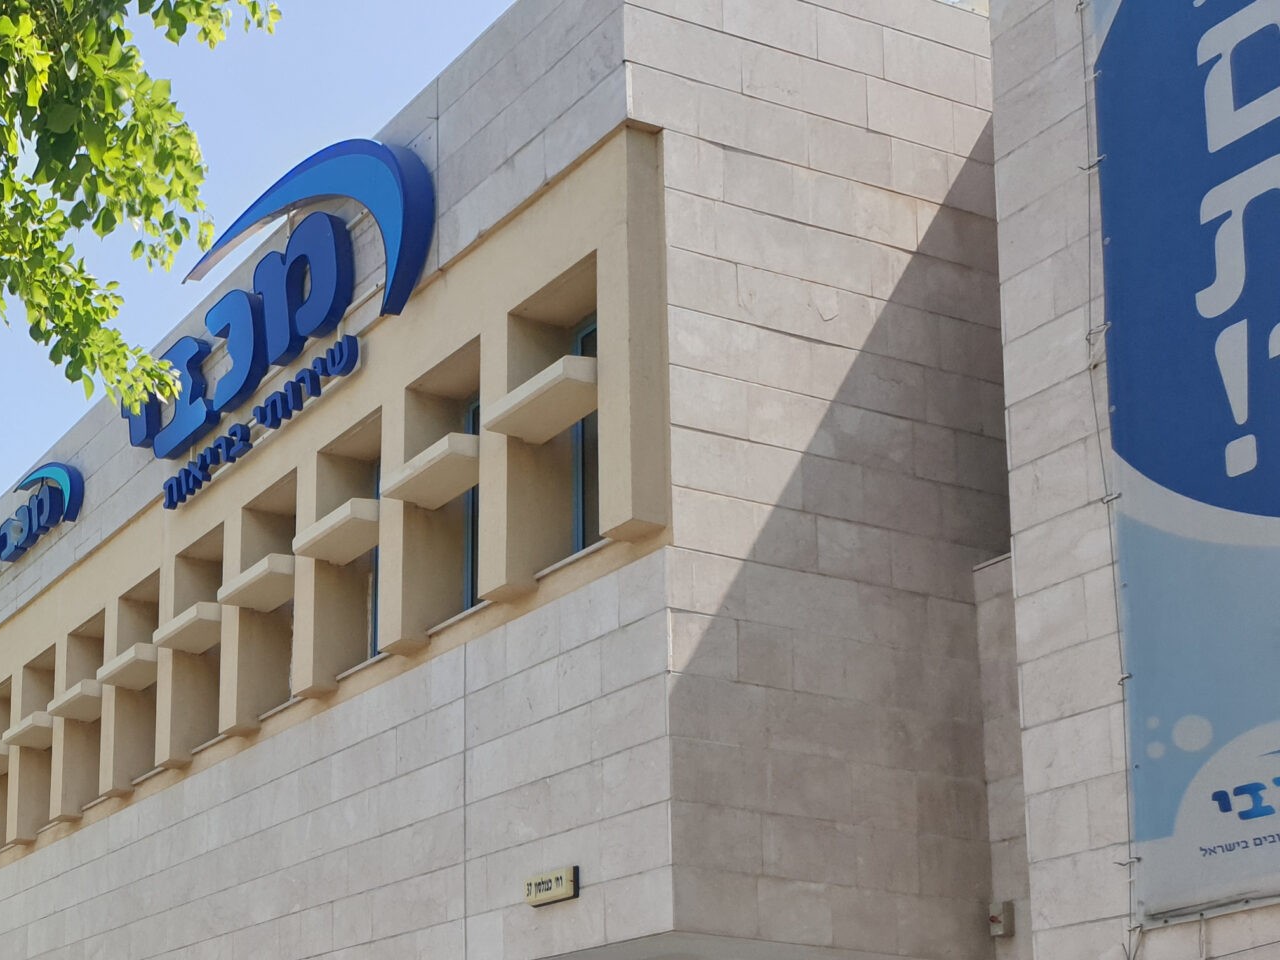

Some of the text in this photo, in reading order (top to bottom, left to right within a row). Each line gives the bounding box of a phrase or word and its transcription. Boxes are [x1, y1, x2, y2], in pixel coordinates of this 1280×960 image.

[121, 211, 356, 460] מכבי
[163, 334, 360, 510] שירותי בריאות
[1199, 840, 1250, 857] בישראל
[1212, 776, 1280, 821] בי
